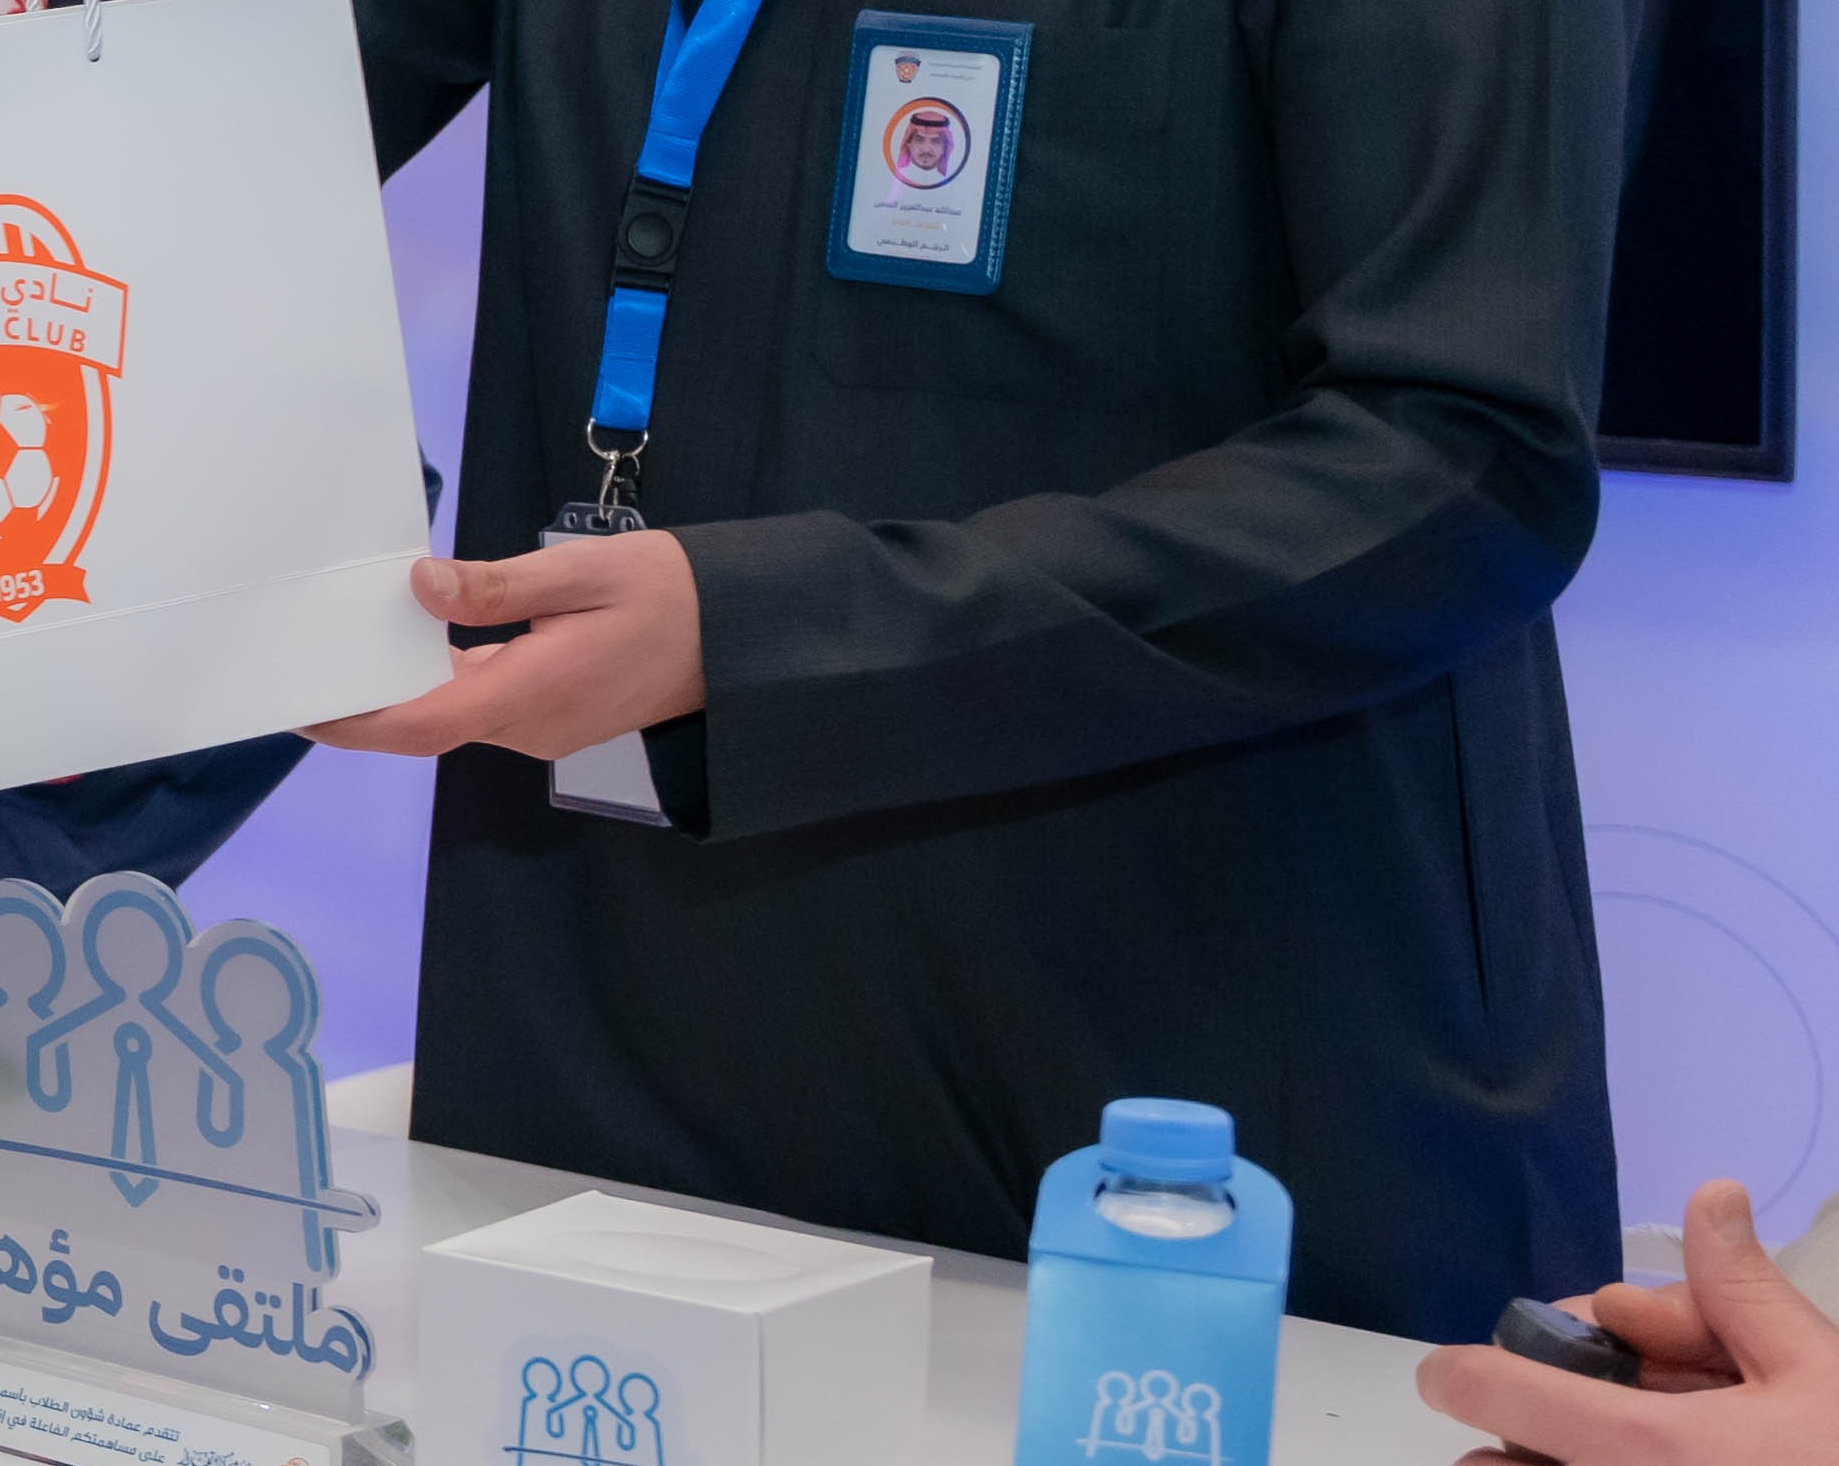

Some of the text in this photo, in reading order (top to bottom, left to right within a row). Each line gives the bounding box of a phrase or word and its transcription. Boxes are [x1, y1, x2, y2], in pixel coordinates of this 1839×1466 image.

[0, 273, 94, 313] نادي
[3, 317, 88, 353] CLUB
[149, 1264, 359, 1374] ملتقى
[29, 1396, 70, 1414] الطلاب
[70, 1407, 105, 1423] شؤون
[7, 1415, 28, 1429] في
[29, 1415, 70, 1438] الفاعلة
[106, 1413, 142, 1433] عمادة
[70, 1431, 137, 1456] مساهمتكم
[142, 1425, 181, 1443] تتقدم
[138, 1448, 166, 1464] على
